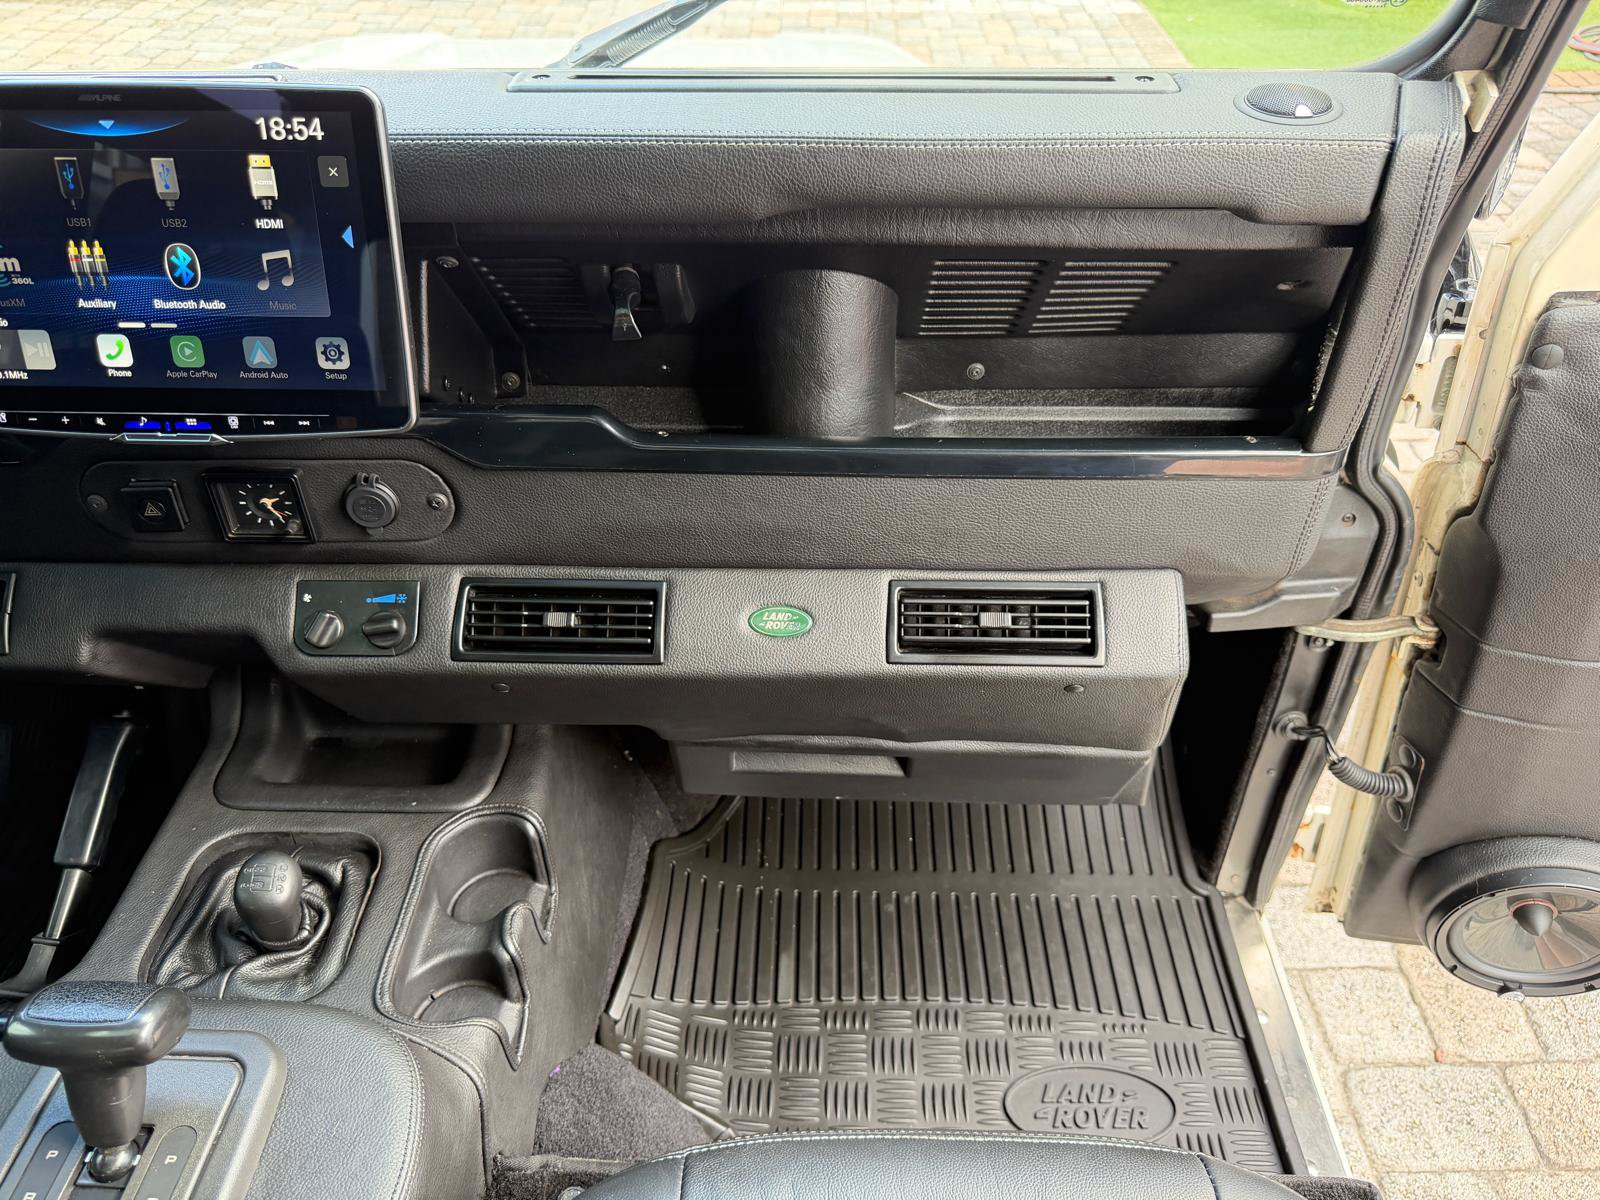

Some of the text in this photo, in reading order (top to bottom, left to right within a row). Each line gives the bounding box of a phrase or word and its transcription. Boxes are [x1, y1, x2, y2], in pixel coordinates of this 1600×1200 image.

[255, 116, 325, 141] 18:54
[66, 217, 91, 227] USB1
[161, 218, 188, 228] USB2
[255, 218, 284, 229] HDMI
[12, 277, 35, 285] 360L
[78, 298, 117, 310] Auxiliary
[154, 299, 226, 310] Bluetooth Audio
[269, 300, 297, 310] Music
[108, 368, 132, 377] Phone
[166, 370, 218, 379] Apple CarPlay
[239, 371, 289, 379] Android Auto
[325, 371, 347, 380] Setup
[762, 612, 792, 620] LAND
[1041, 1083, 1115, 1104] LAND
[1051, 1106, 1150, 1130] ROVER
[45, 1150, 59, 1160] P
[164, 1155, 178, 1165] P
